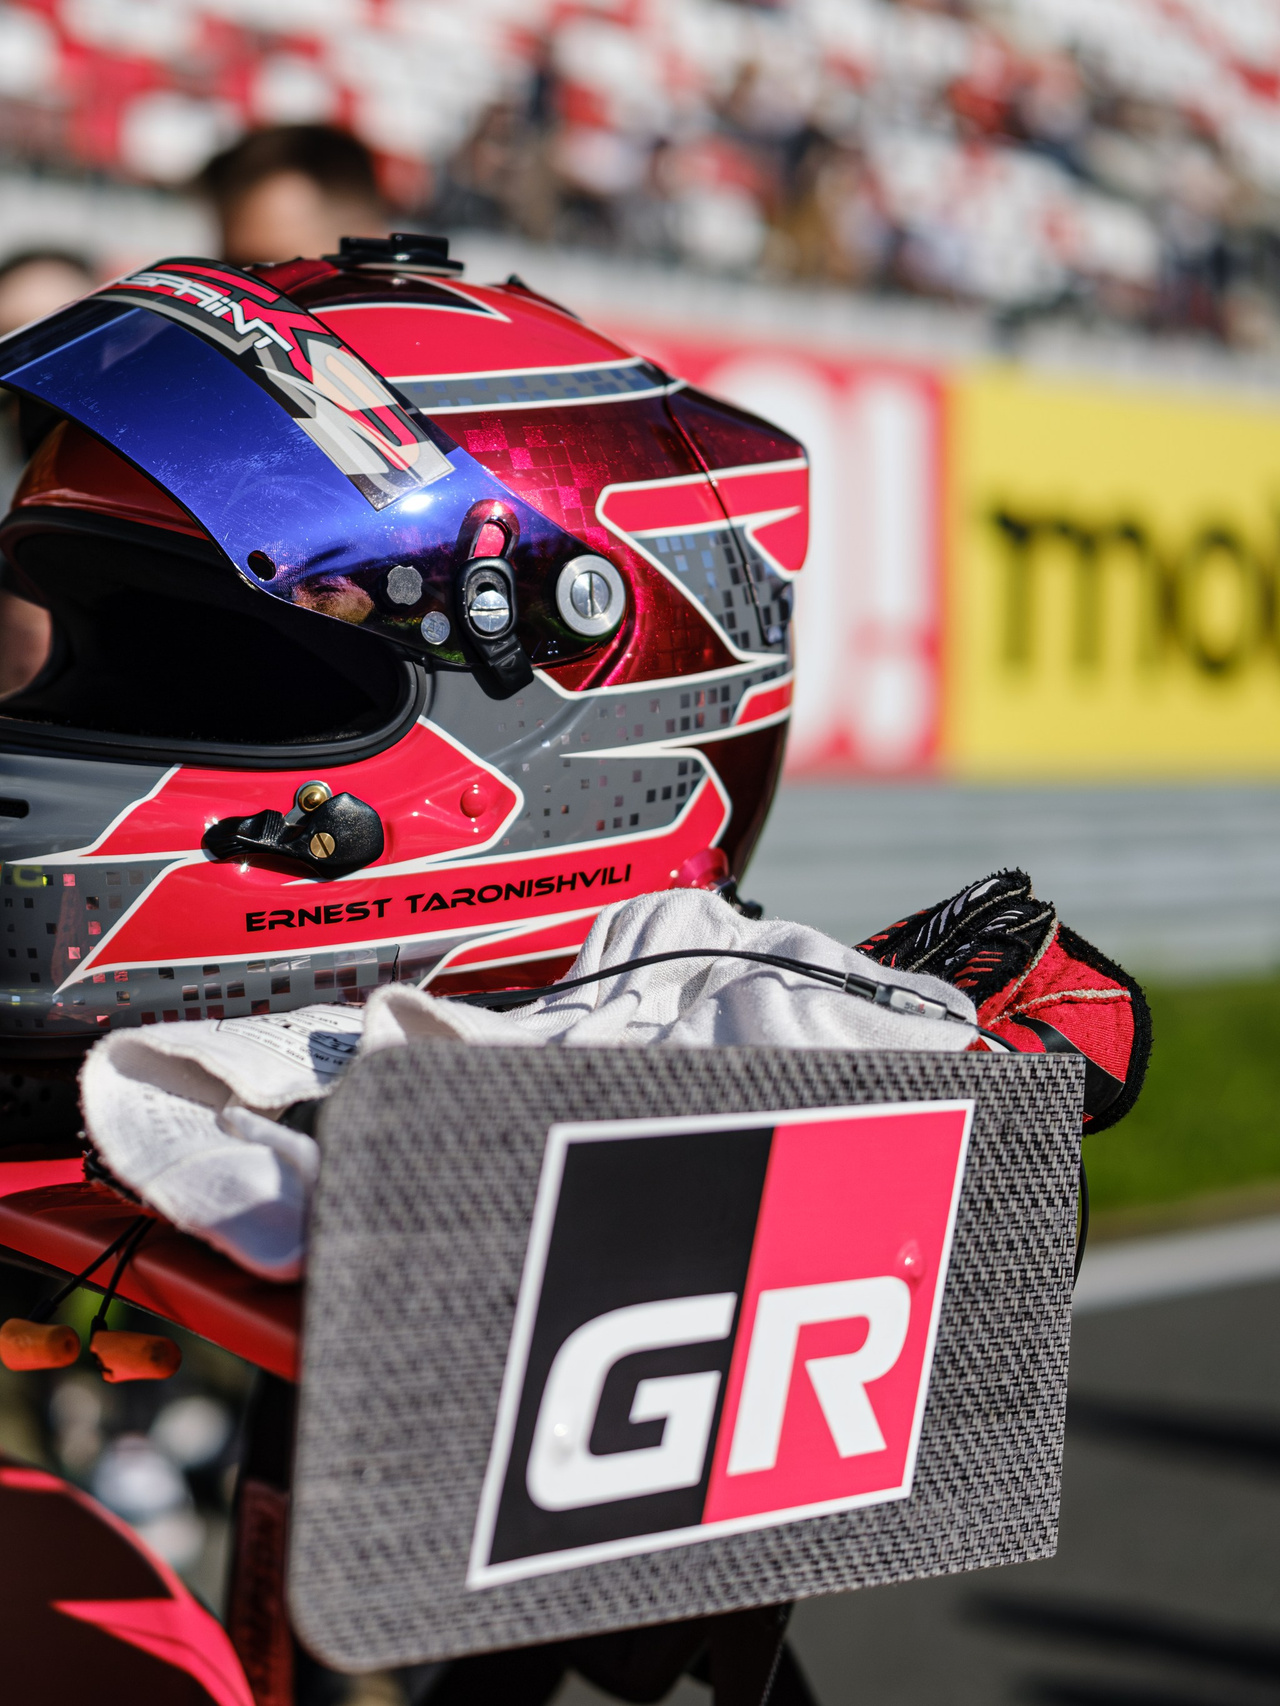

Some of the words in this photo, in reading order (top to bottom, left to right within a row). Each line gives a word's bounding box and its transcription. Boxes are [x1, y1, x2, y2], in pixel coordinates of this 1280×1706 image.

[245, 898, 393, 932] ERNEST
[405, 864, 632, 914] TARONISHVILI
[525, 1275, 911, 1512] GR
